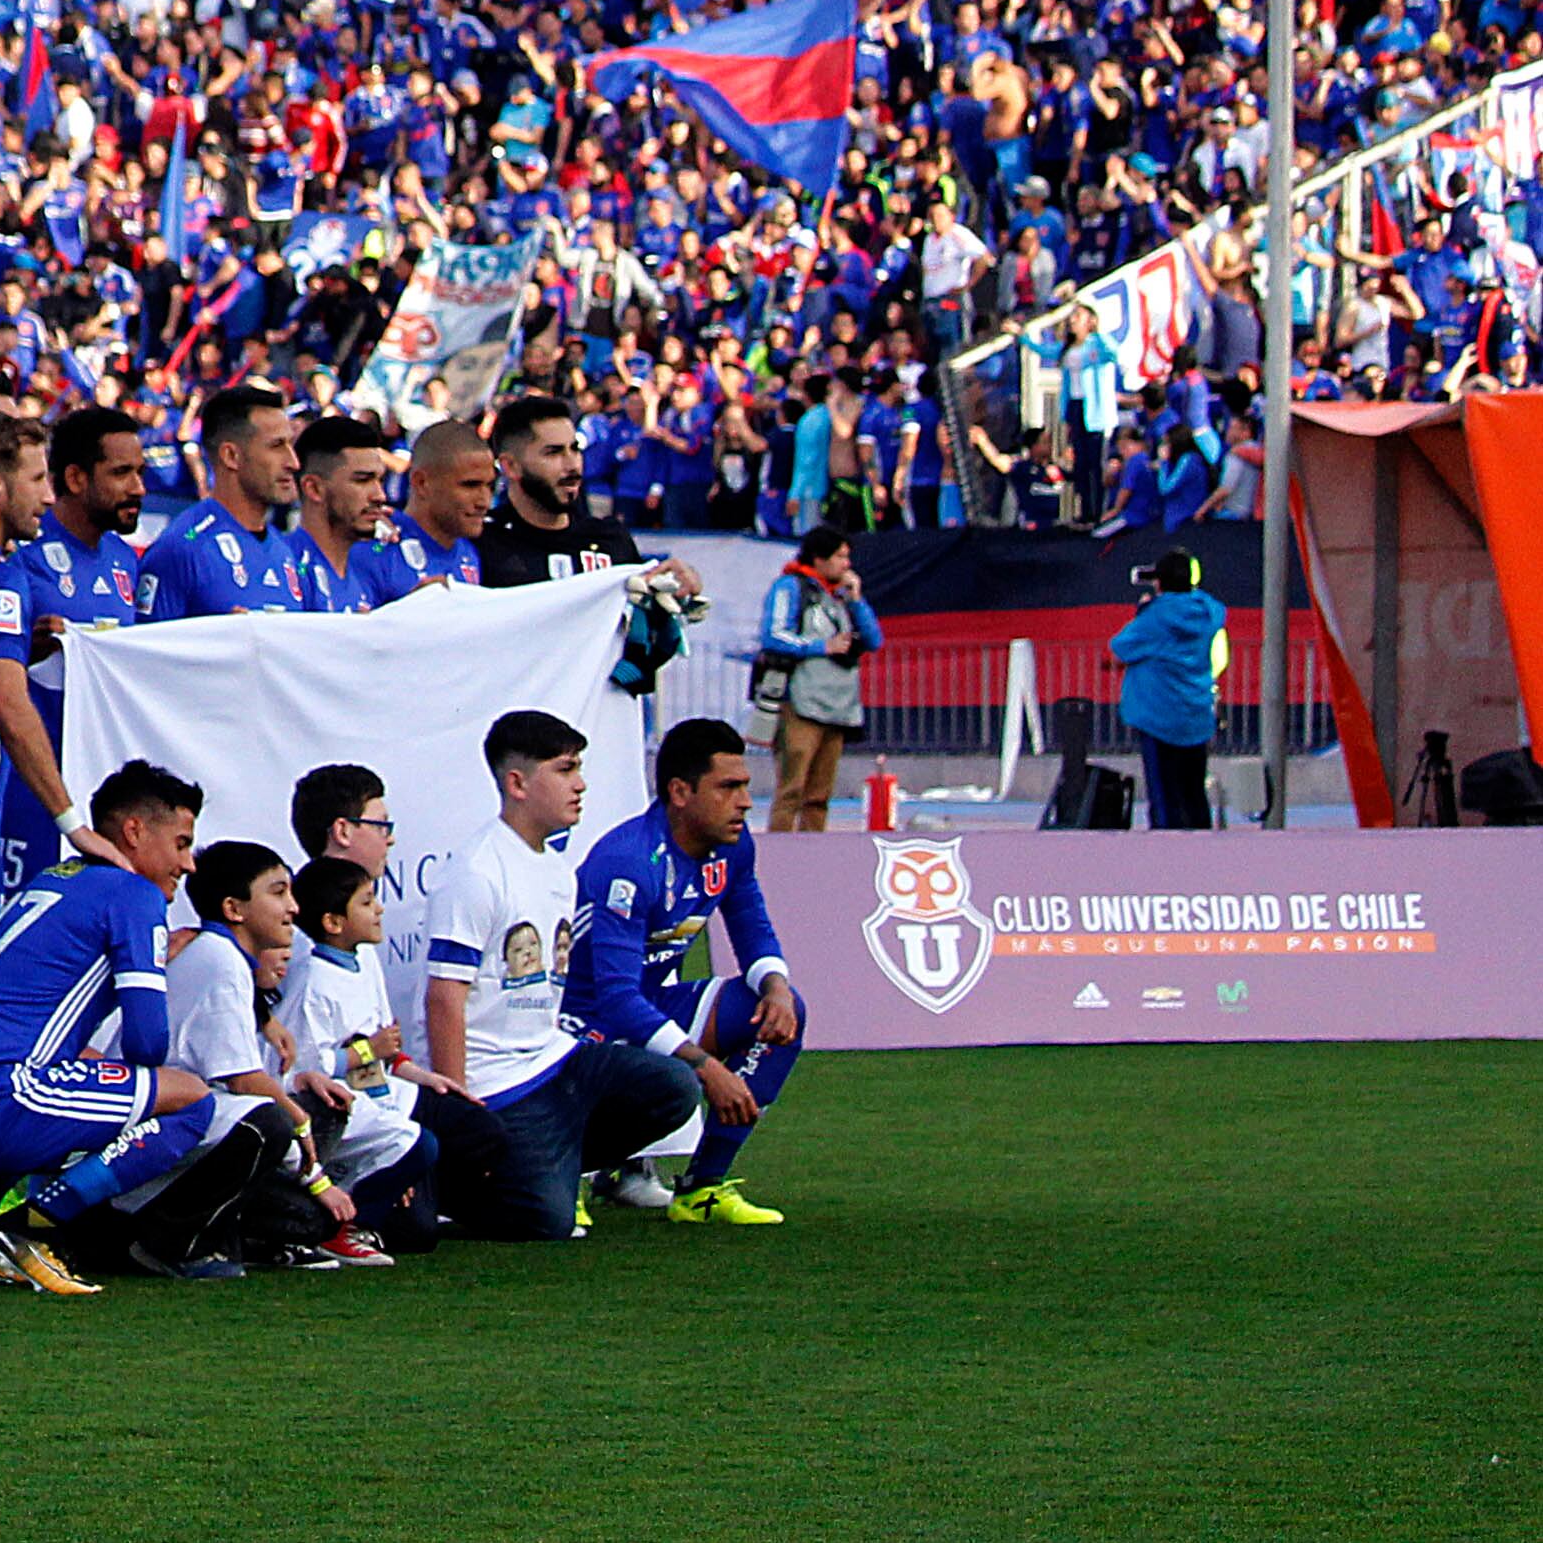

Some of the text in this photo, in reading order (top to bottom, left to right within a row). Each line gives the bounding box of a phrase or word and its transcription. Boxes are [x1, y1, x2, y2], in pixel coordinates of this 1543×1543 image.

[993, 893, 1426, 933] CLUB UNIVERSIDAD DE CHILE
